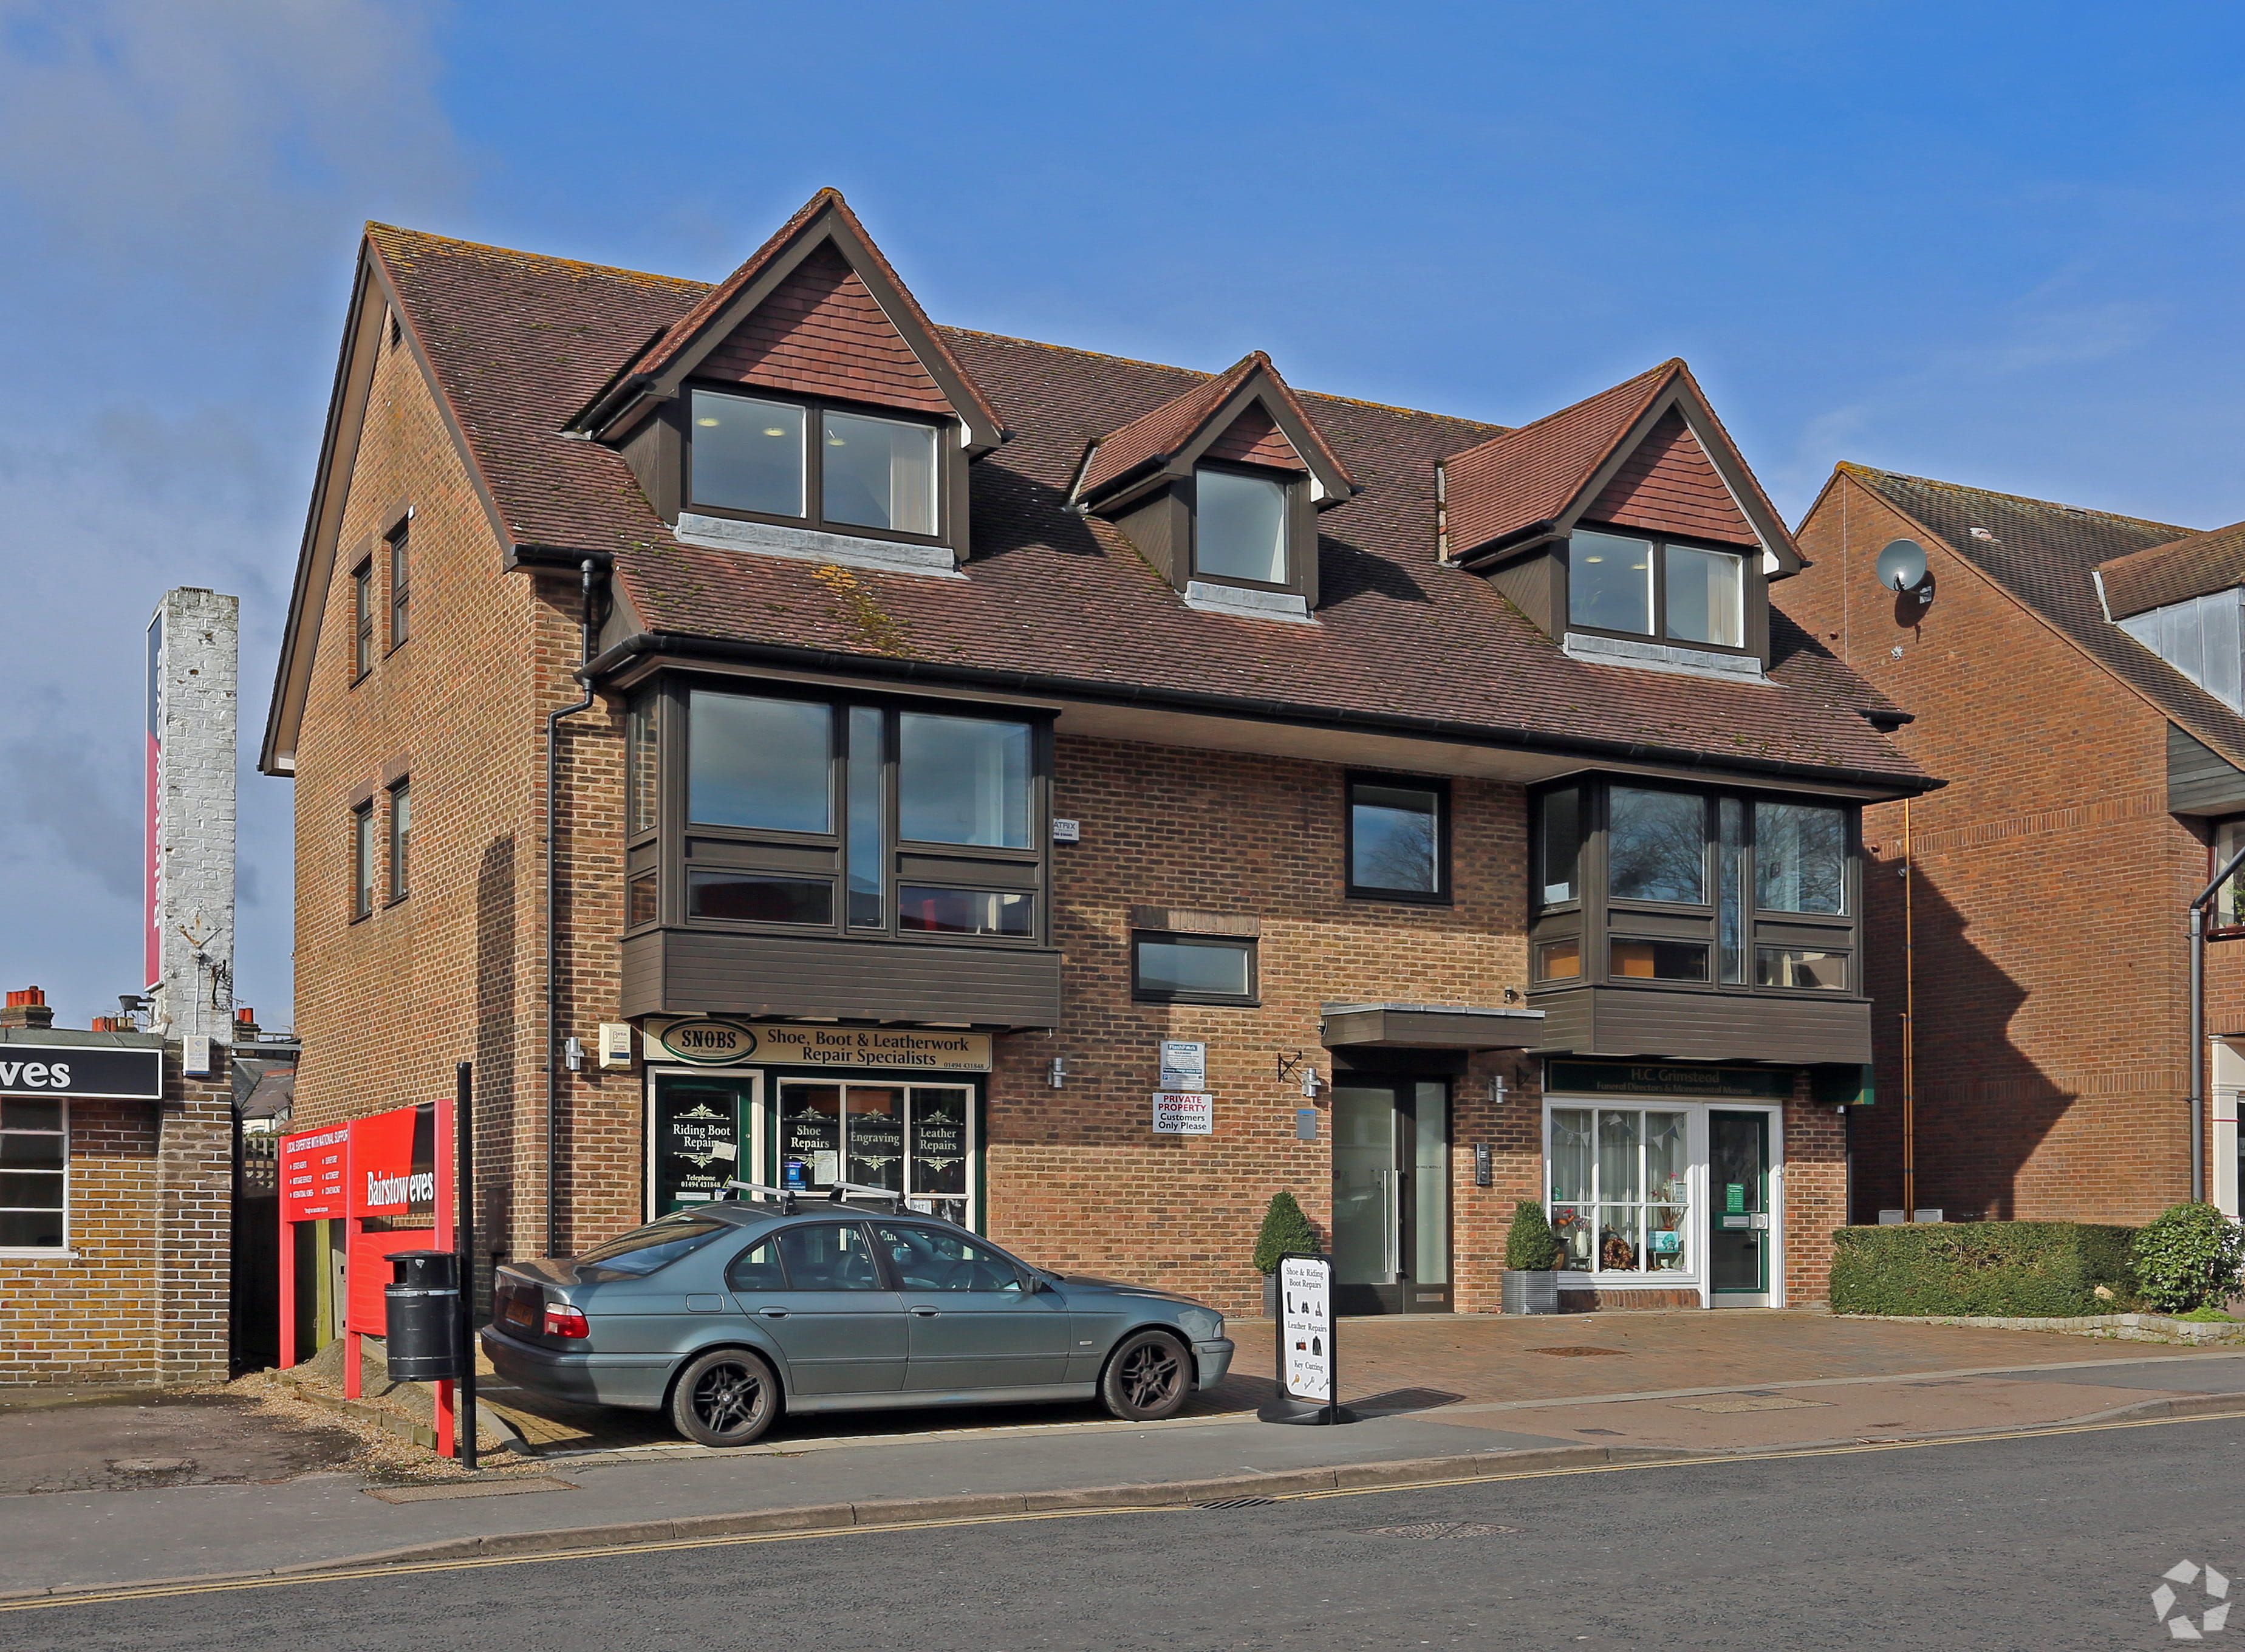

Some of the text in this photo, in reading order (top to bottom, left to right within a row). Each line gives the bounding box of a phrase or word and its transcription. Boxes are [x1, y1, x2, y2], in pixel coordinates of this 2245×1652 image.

[682, 1029, 737, 1049] SNOBS
[768, 1029, 969, 1051] Shoe, Boot & Leatherwork
[802, 1046, 936, 1066] Repair Specialists
[1631, 1068, 1720, 1083] H.C. Grimstead
[1597, 1082, 1626, 1090] Funeral
[1627, 1082, 1663, 1092] Directors
[1672, 1085, 1721, 1093] Monumental
[1163, 1095, 1202, 1104] PRIVATE
[1158, 1104, 1207, 1112] PROPERTY
[1160, 1113, 1205, 1122] Customers
[673, 1124, 731, 1139] Riding Boot
[797, 1125, 821, 1136] Shoe
[920, 1128, 957, 1138] Leather
[1158, 1121, 1207, 1131] Only Please
[791, 1137, 830, 1151] Repairs
[850, 1131, 900, 1146] Engraving
[920, 1139, 957, 1153] Repairs
[366, 1170, 434, 1206] Bairstow eves
[1286, 1267, 1299, 1276] Shoe
[1306, 1268, 1324, 1280] Riding
[1289, 1278, 1322, 1290] Boot Repairs
[1288, 1320, 1327, 1334] Leather Repairs
[1294, 1360, 1324, 1374] Key Cutting
